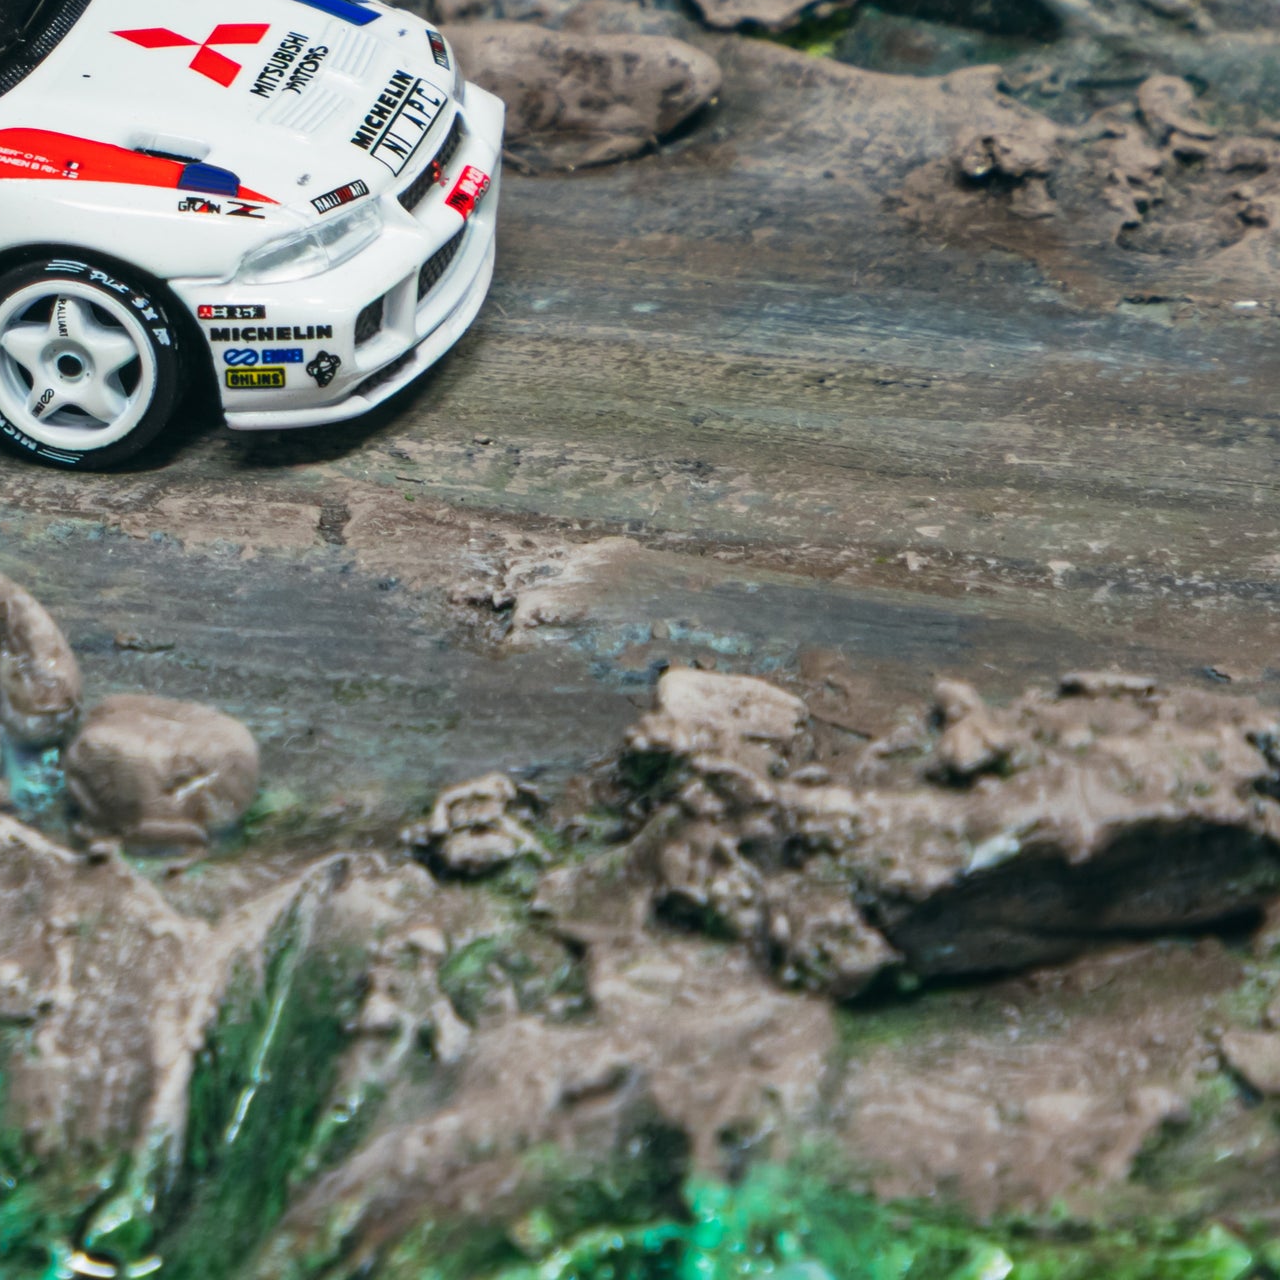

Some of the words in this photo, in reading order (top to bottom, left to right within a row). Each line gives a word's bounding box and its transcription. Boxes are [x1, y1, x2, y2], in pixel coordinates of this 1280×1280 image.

[250, 31, 309, 99] MITSUBISHI
[350, 70, 414, 150] MICHELIN
[210, 324, 333, 342] MICHELIN
